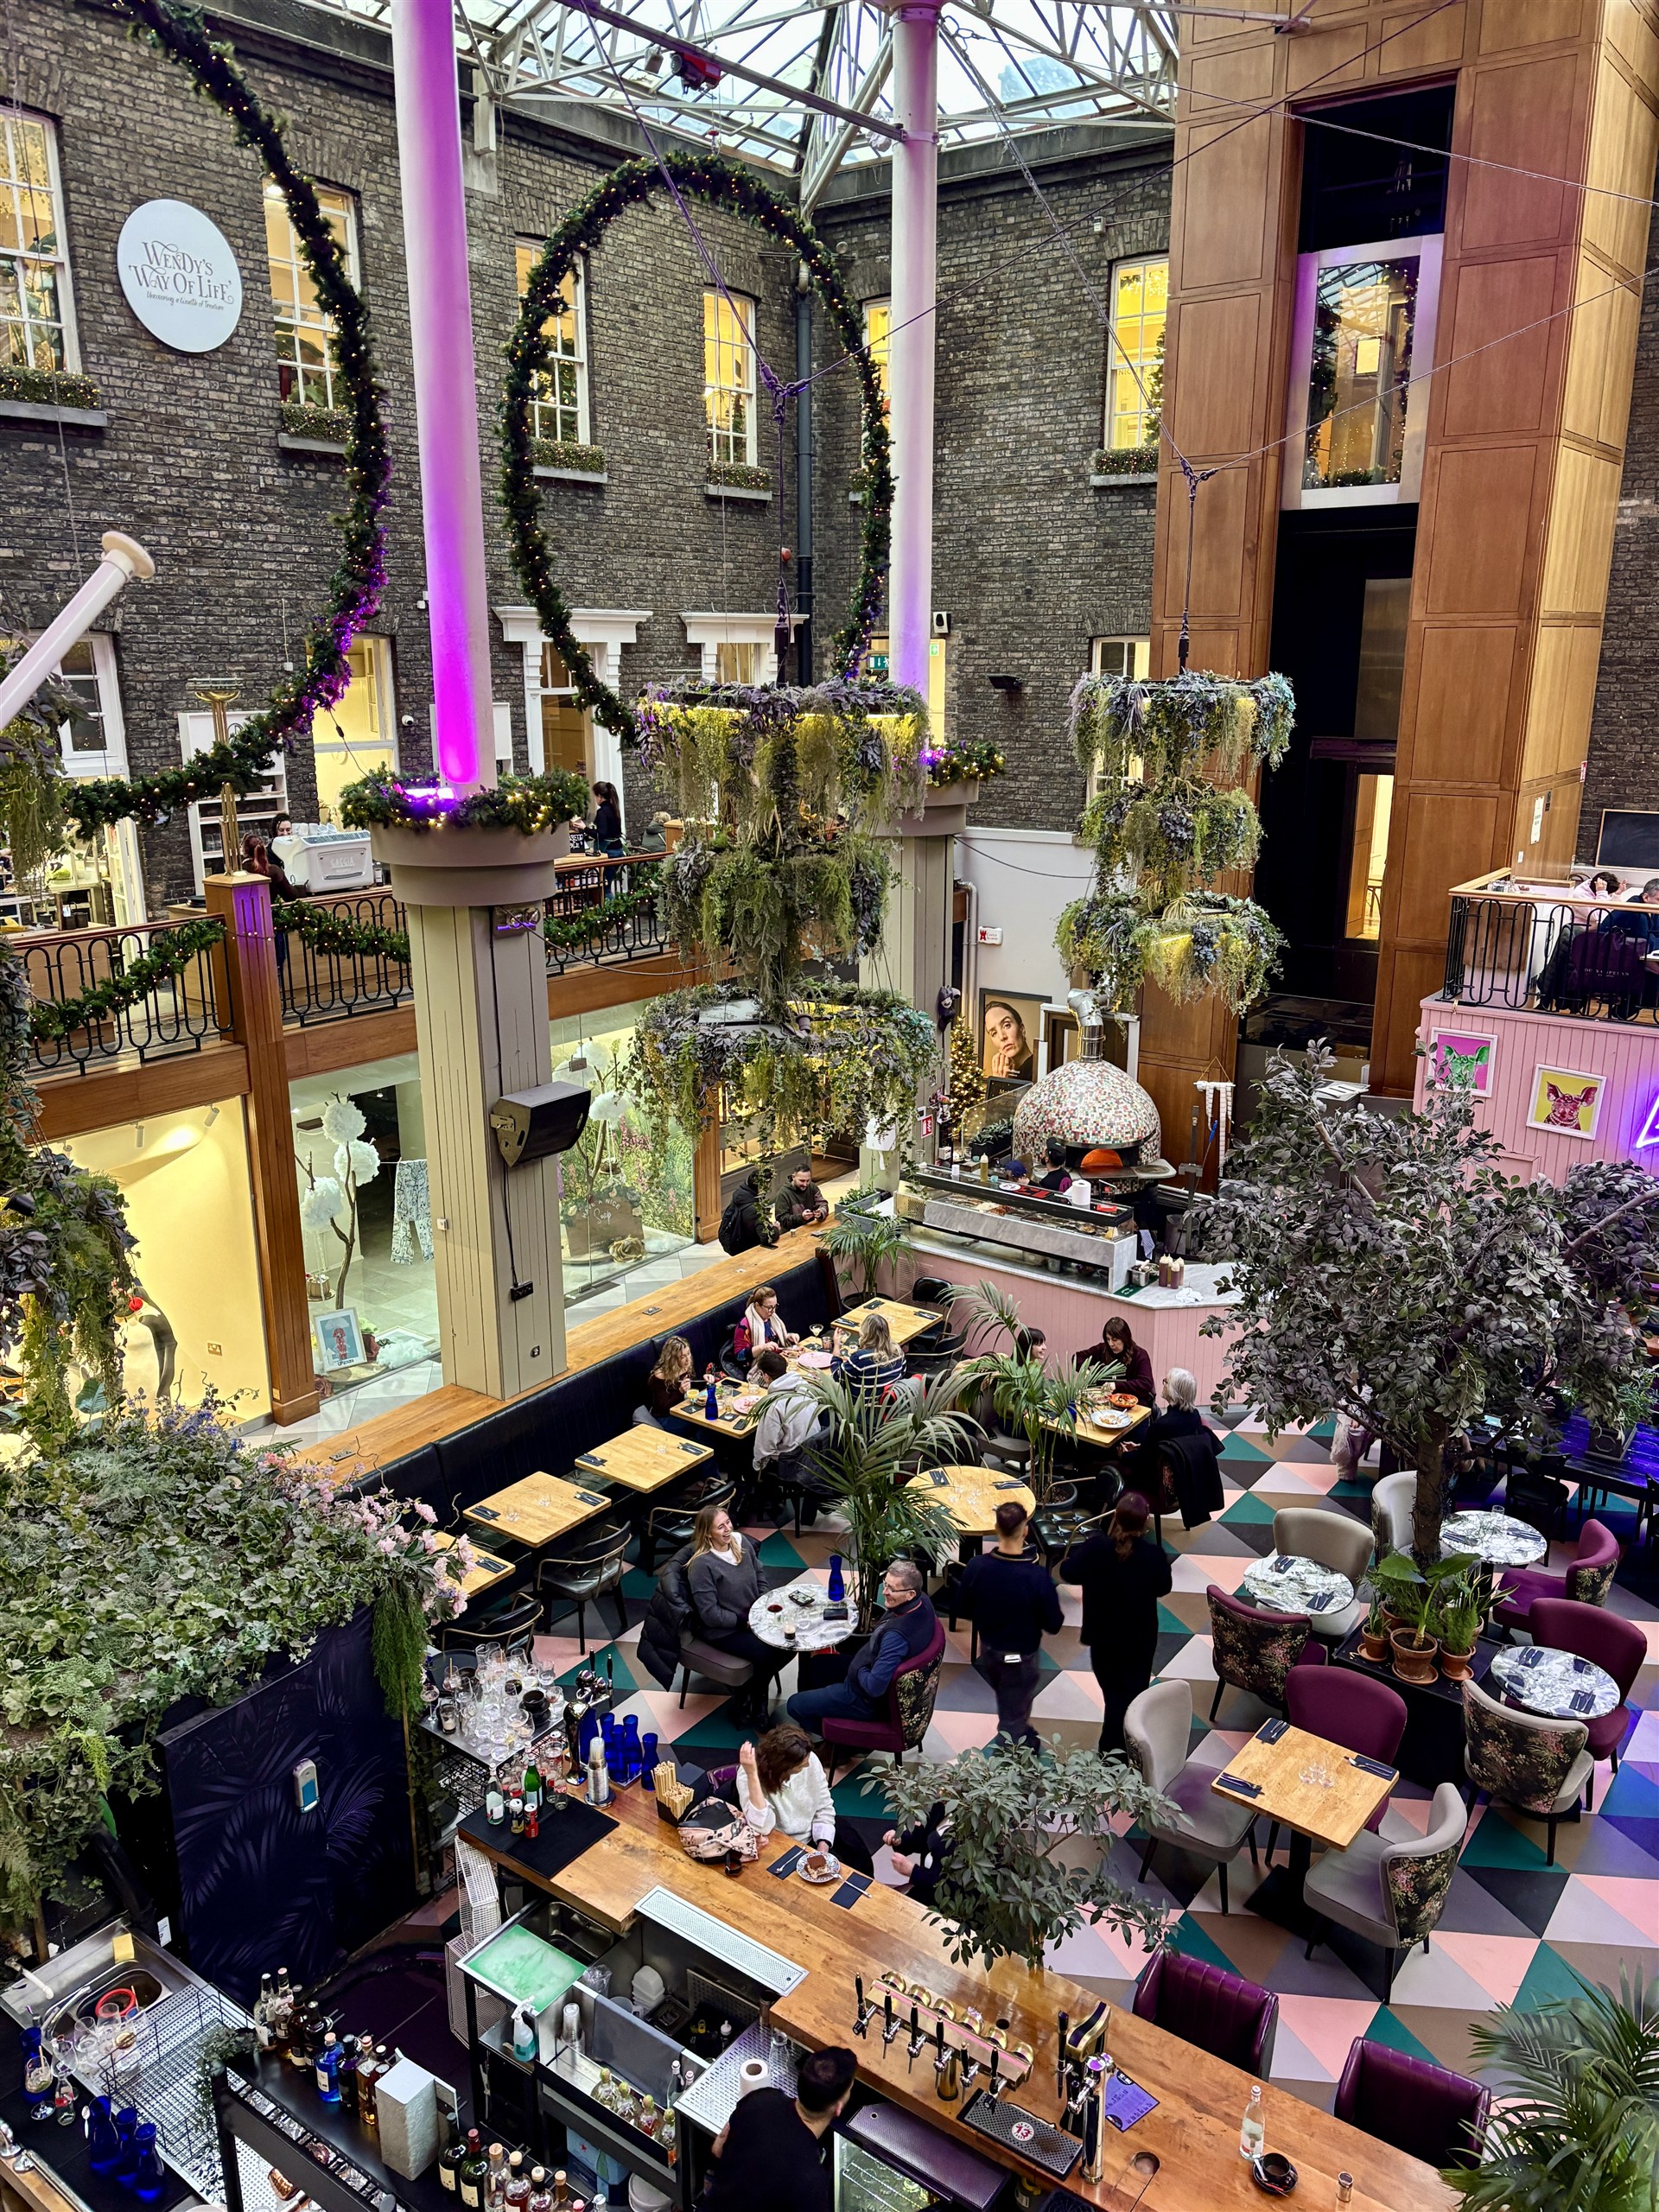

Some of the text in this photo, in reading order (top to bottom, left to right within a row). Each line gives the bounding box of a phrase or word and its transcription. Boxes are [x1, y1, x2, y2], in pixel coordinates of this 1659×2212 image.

[141, 240, 213, 276] WENDY'S
[605, 1198, 621, 1210] NICE
[1016, 2124, 1031, 2139] 13
